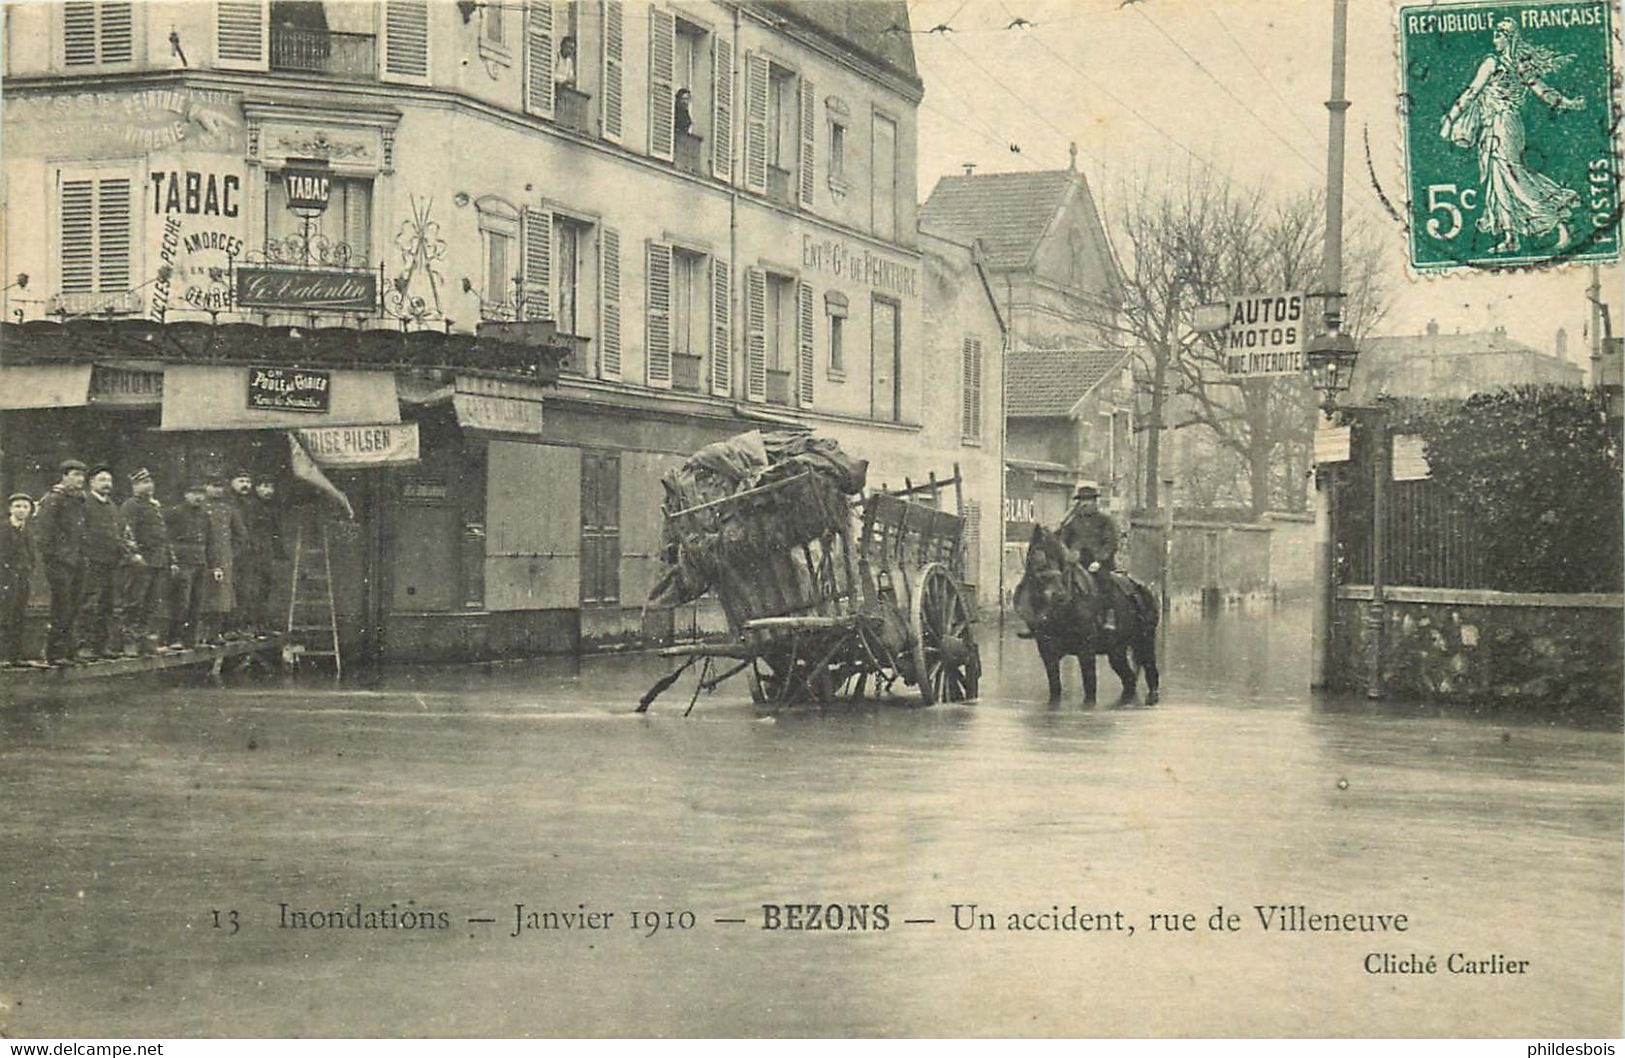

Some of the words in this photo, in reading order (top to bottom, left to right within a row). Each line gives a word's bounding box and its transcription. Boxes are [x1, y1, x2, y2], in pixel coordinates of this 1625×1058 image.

[1521, 6, 1602, 29] FRANÇAISE
[151, 171, 240, 218] TABAC
[289, 176, 329, 201] TABAC
[1590, 158, 1613, 244] POSTES
[184, 231, 243, 256] AMORCES
[1232, 296, 1301, 325] AUTOS
[1230, 327, 1296, 349] MOTOS
[1249, 351, 1301, 373] INTERDITE
[344, 430, 391, 452] PILSEN
[1005, 498, 1035, 522] BLANC
